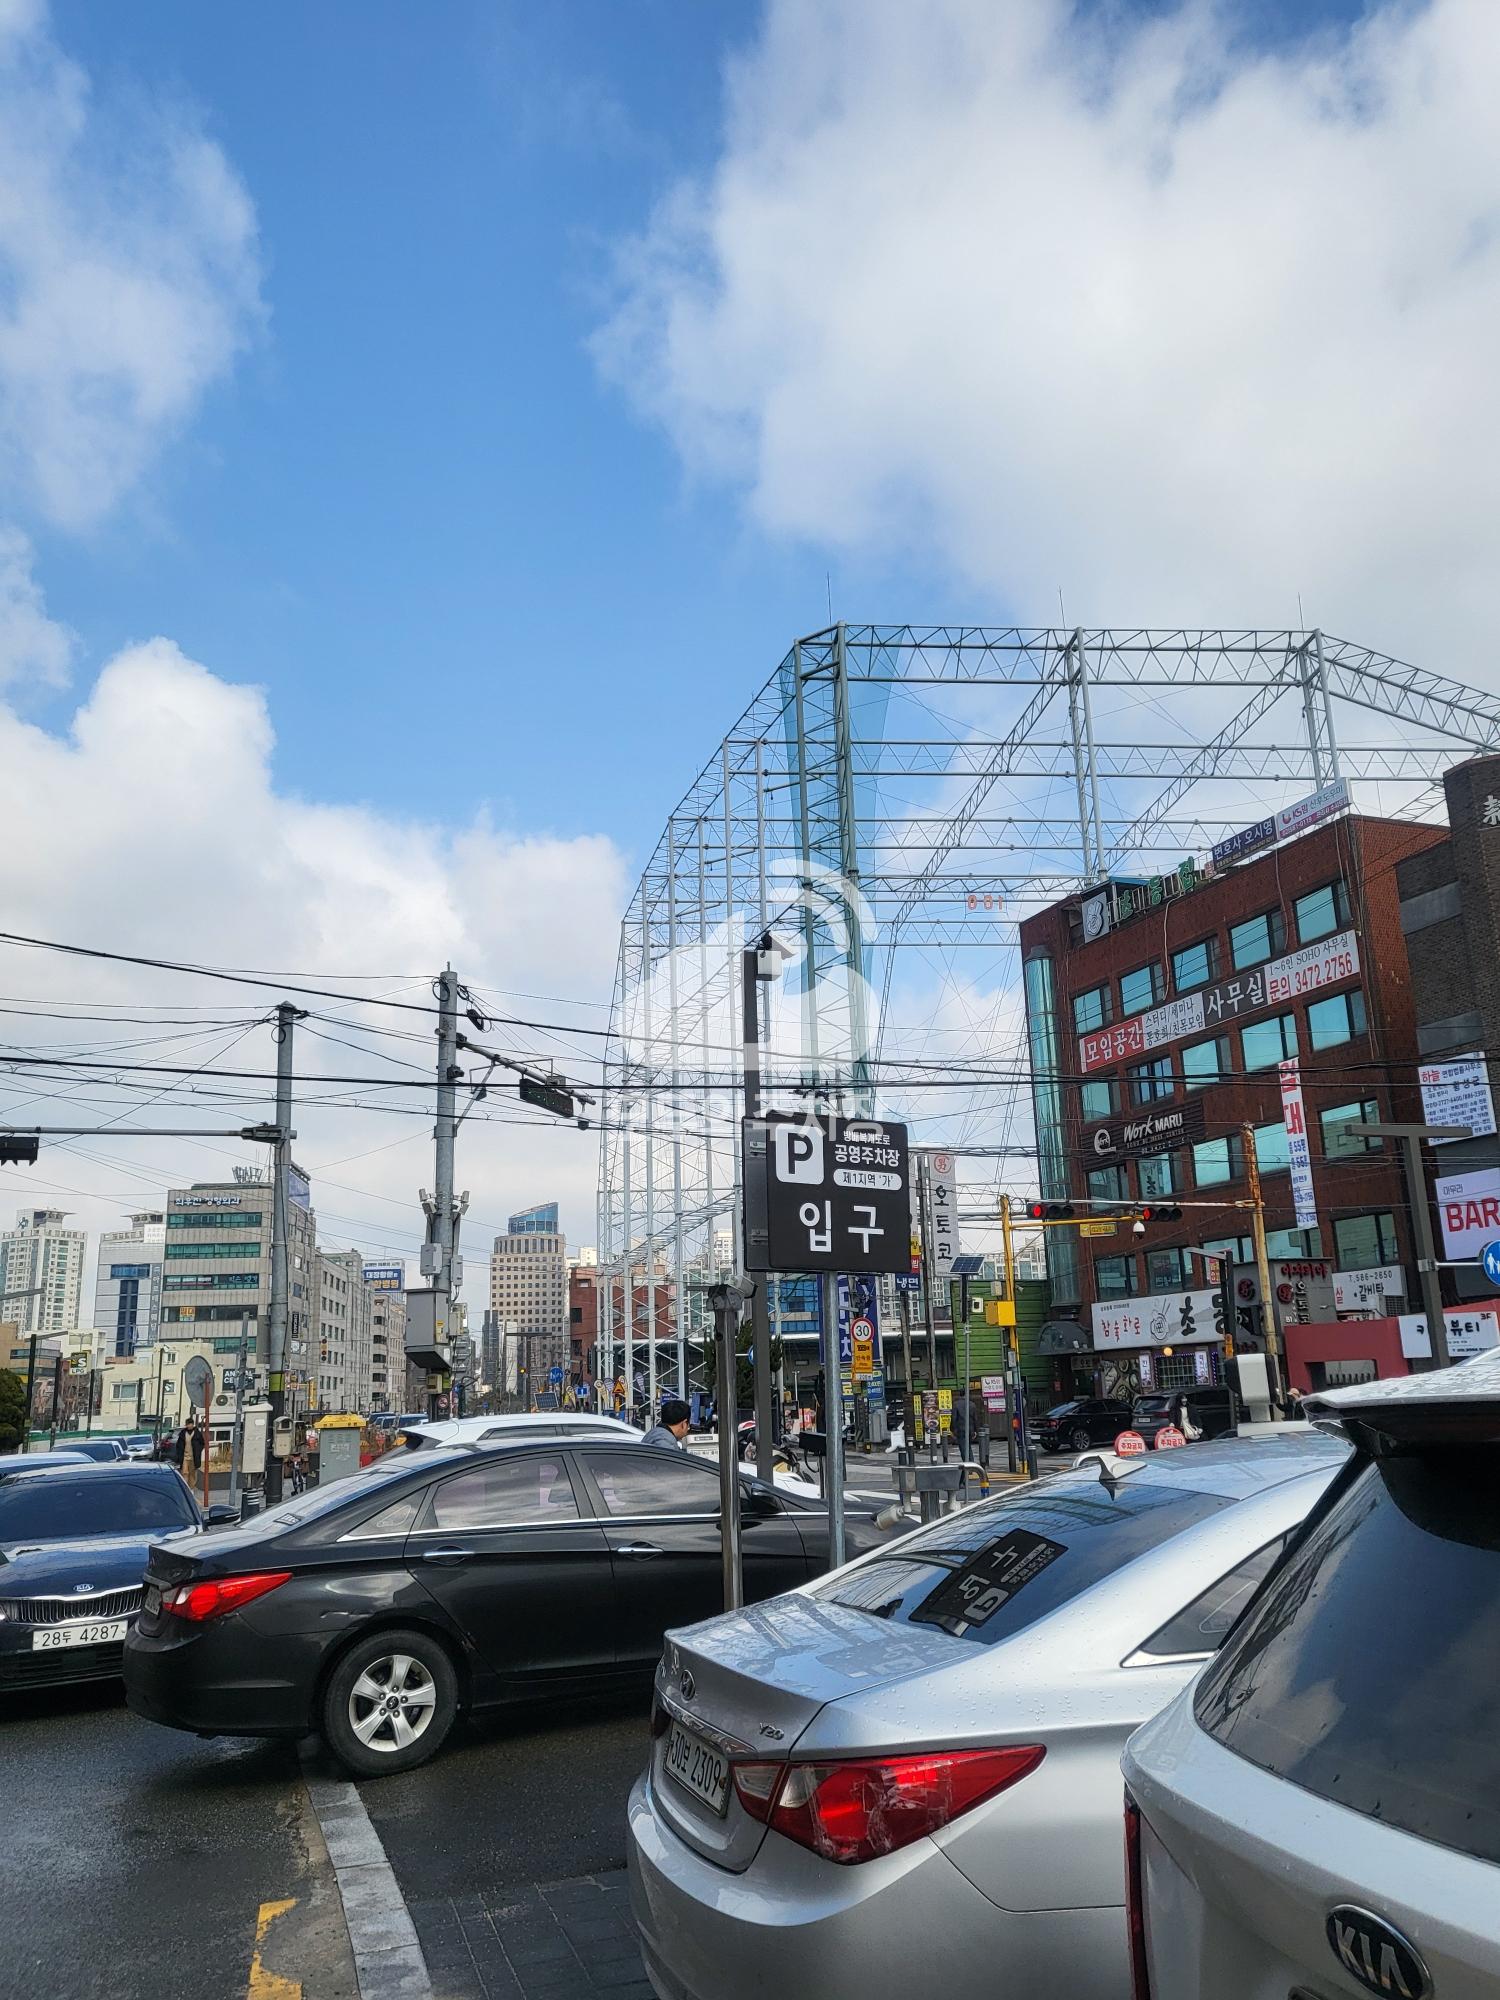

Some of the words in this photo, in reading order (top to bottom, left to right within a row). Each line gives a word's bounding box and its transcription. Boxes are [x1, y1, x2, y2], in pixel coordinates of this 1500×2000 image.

[1214, 839, 1241, 860] 변호사
[1244, 818, 1273, 846] 오시영
[1296, 946, 1321, 966] SOHO
[1322, 933, 1348, 954] 사무실
[1269, 974, 1292, 1003] 문의
[1295, 952, 1353, 993] 3472.2756
[1207, 972, 1265, 1019] 사무실
[1145, 997, 1194, 1028] 스터디/세미나
[1146, 1012, 1203, 1046] 동호회/친목모임
[1086, 1021, 1143, 1063] 모임공간
[1421, 1069, 1441, 1083] 하늘
[1123, 1115, 1153, 1143] Work
[1154, 1113, 1183, 1132] MARU
[787, 1132, 814, 1175] P
[834, 1144, 900, 1167] 공영주차장
[842, 1171, 876, 1186] 제1지역
[934, 1184, 953, 1261] 오토코
[896, 1276, 919, 1289] 냉면
[855, 1325, 870, 1337] 30
[1120, 1442, 1143, 1450] 주차금지
[42, 1631, 72, 1647] 28두
[79, 1625, 119, 1642] 4287
[691, 1745, 722, 1797] 2309
[1334, 1917, 1415, 2000] KIA
